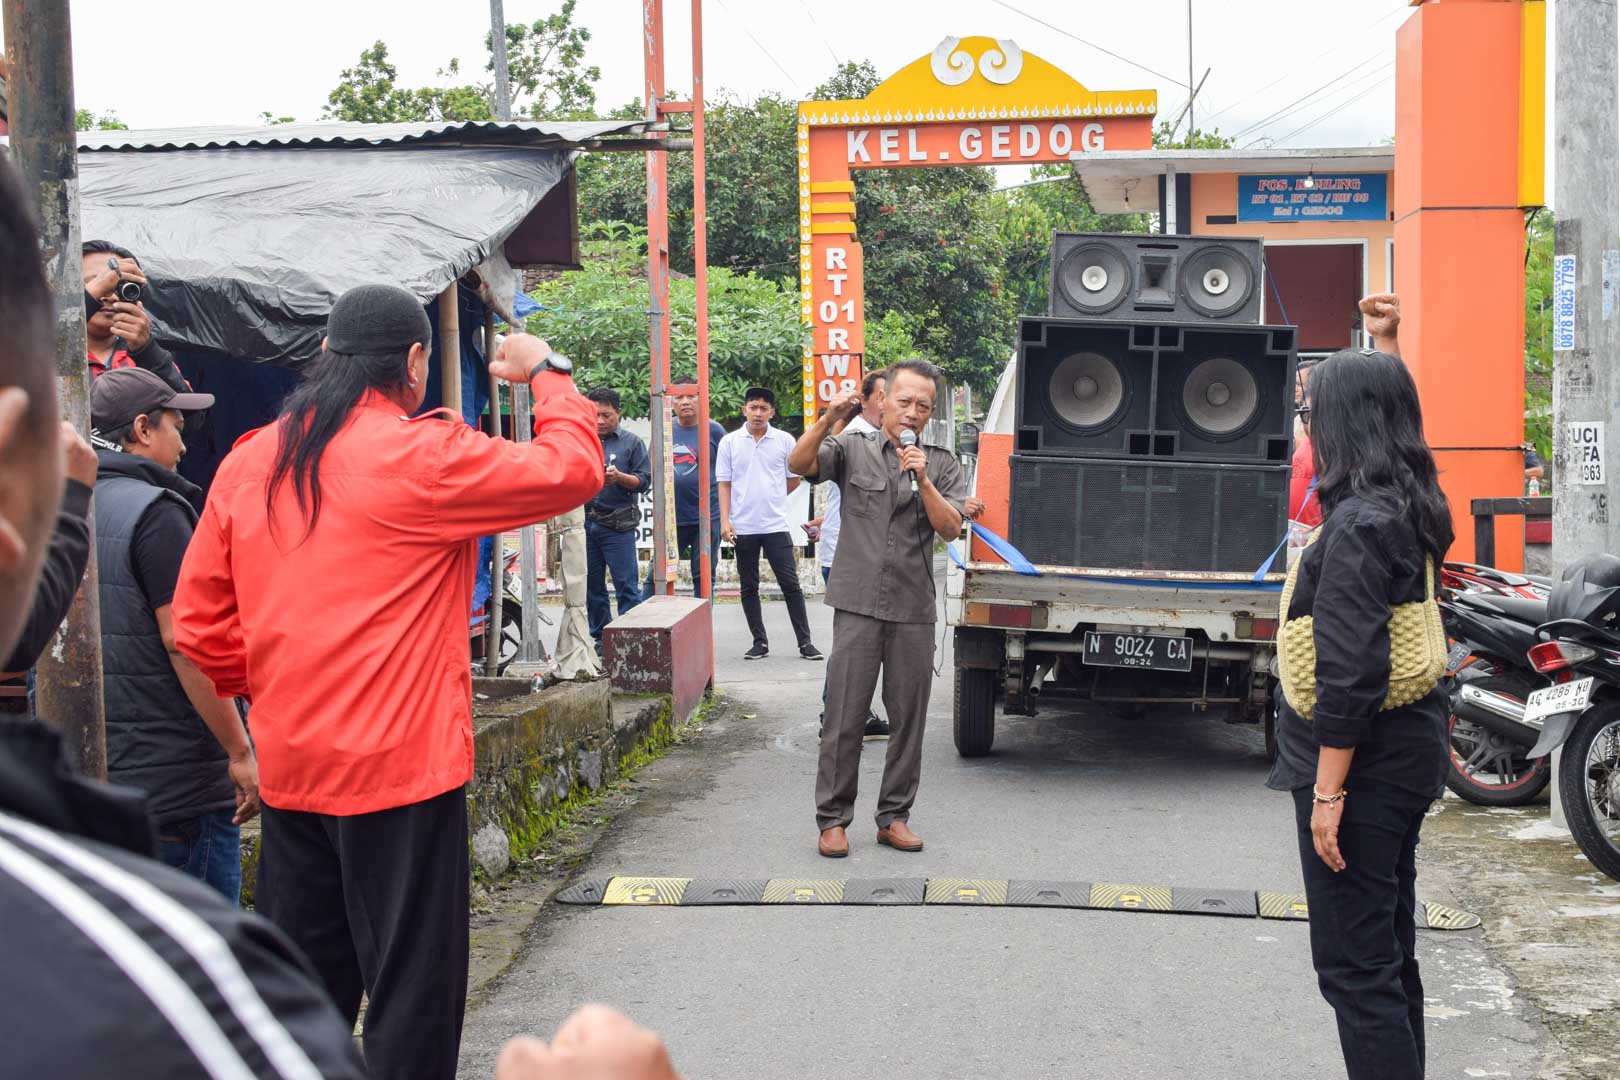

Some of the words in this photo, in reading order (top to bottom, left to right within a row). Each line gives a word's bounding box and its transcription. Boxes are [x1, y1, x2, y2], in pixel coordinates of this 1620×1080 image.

[959, 122, 1105, 160] GEDOG
[1562, 258, 1575, 286] 7799
[819, 300, 856, 323] 01
[1090, 635, 1101, 653] N
[1115, 636, 1154, 657] 9024
[1167, 639, 1186, 659] CA
